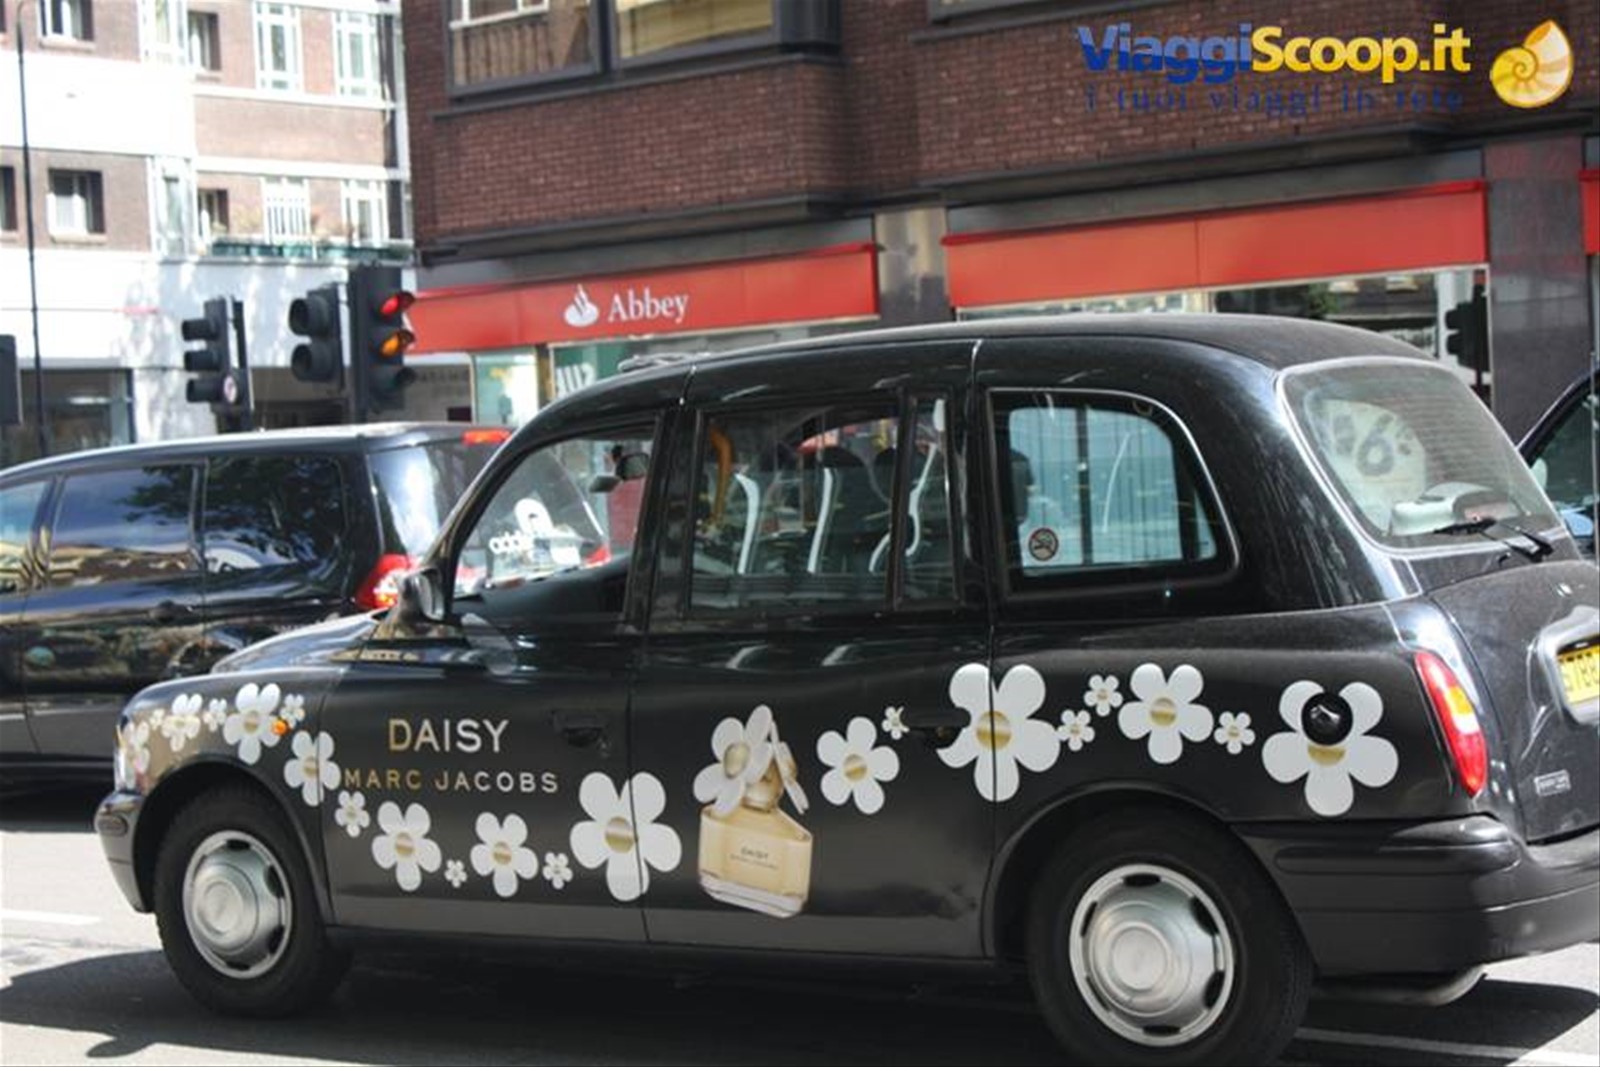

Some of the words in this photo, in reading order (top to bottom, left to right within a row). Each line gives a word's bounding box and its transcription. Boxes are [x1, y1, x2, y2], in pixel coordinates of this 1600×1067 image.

[607, 287, 689, 325] Abbey
[388, 718, 509, 753] DAISY
[344, 768, 422, 790] MARC
[434, 771, 559, 793] JACOBS
